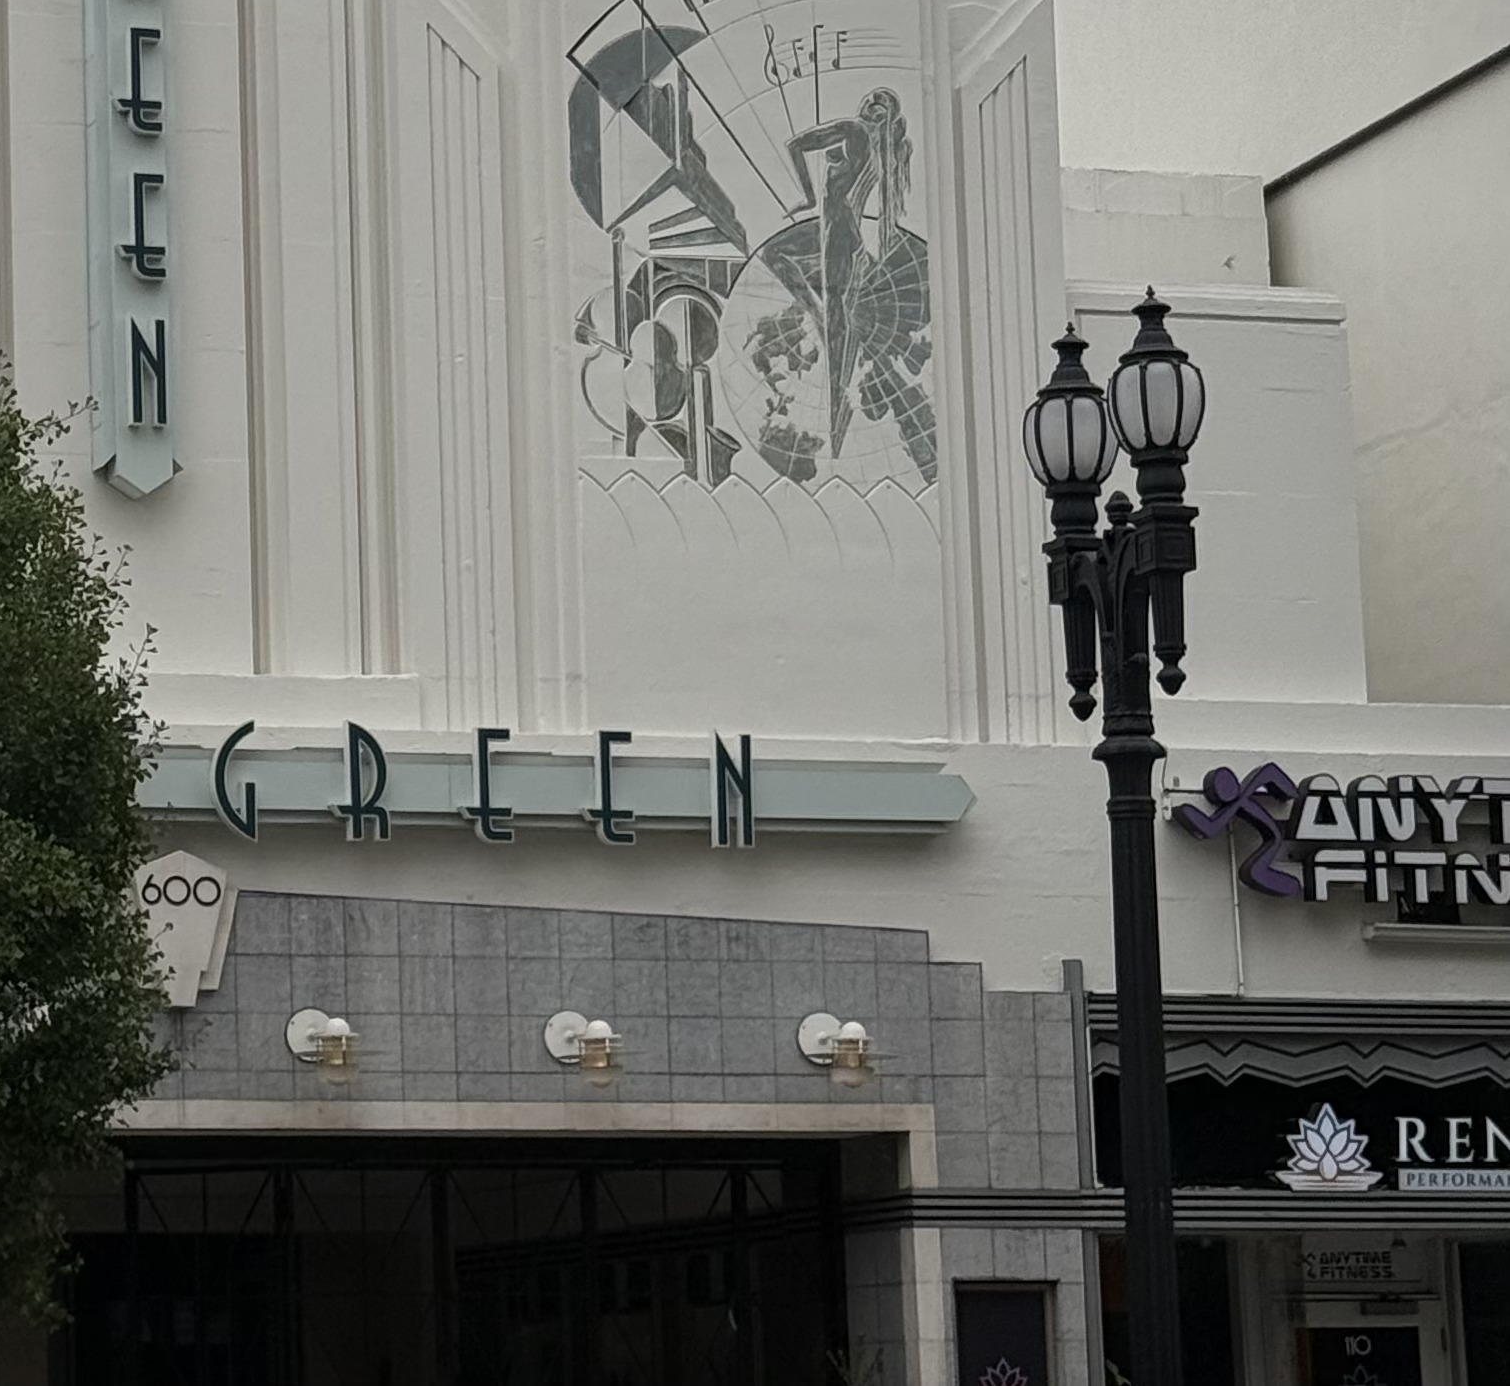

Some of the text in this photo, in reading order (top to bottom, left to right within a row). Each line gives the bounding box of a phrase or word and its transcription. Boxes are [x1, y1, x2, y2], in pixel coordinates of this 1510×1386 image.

[210, 719, 754, 847] GREEN
[142, 874, 221, 907] 600
[1394, 1116, 1510, 1163] REN
[1406, 1173, 1510, 1187] PERFORMA
[1319, 1251, 1392, 1264] ANYTIME
[1319, 1265, 1394, 1279] FITNESS
[1344, 1335, 1371, 1357] 110
